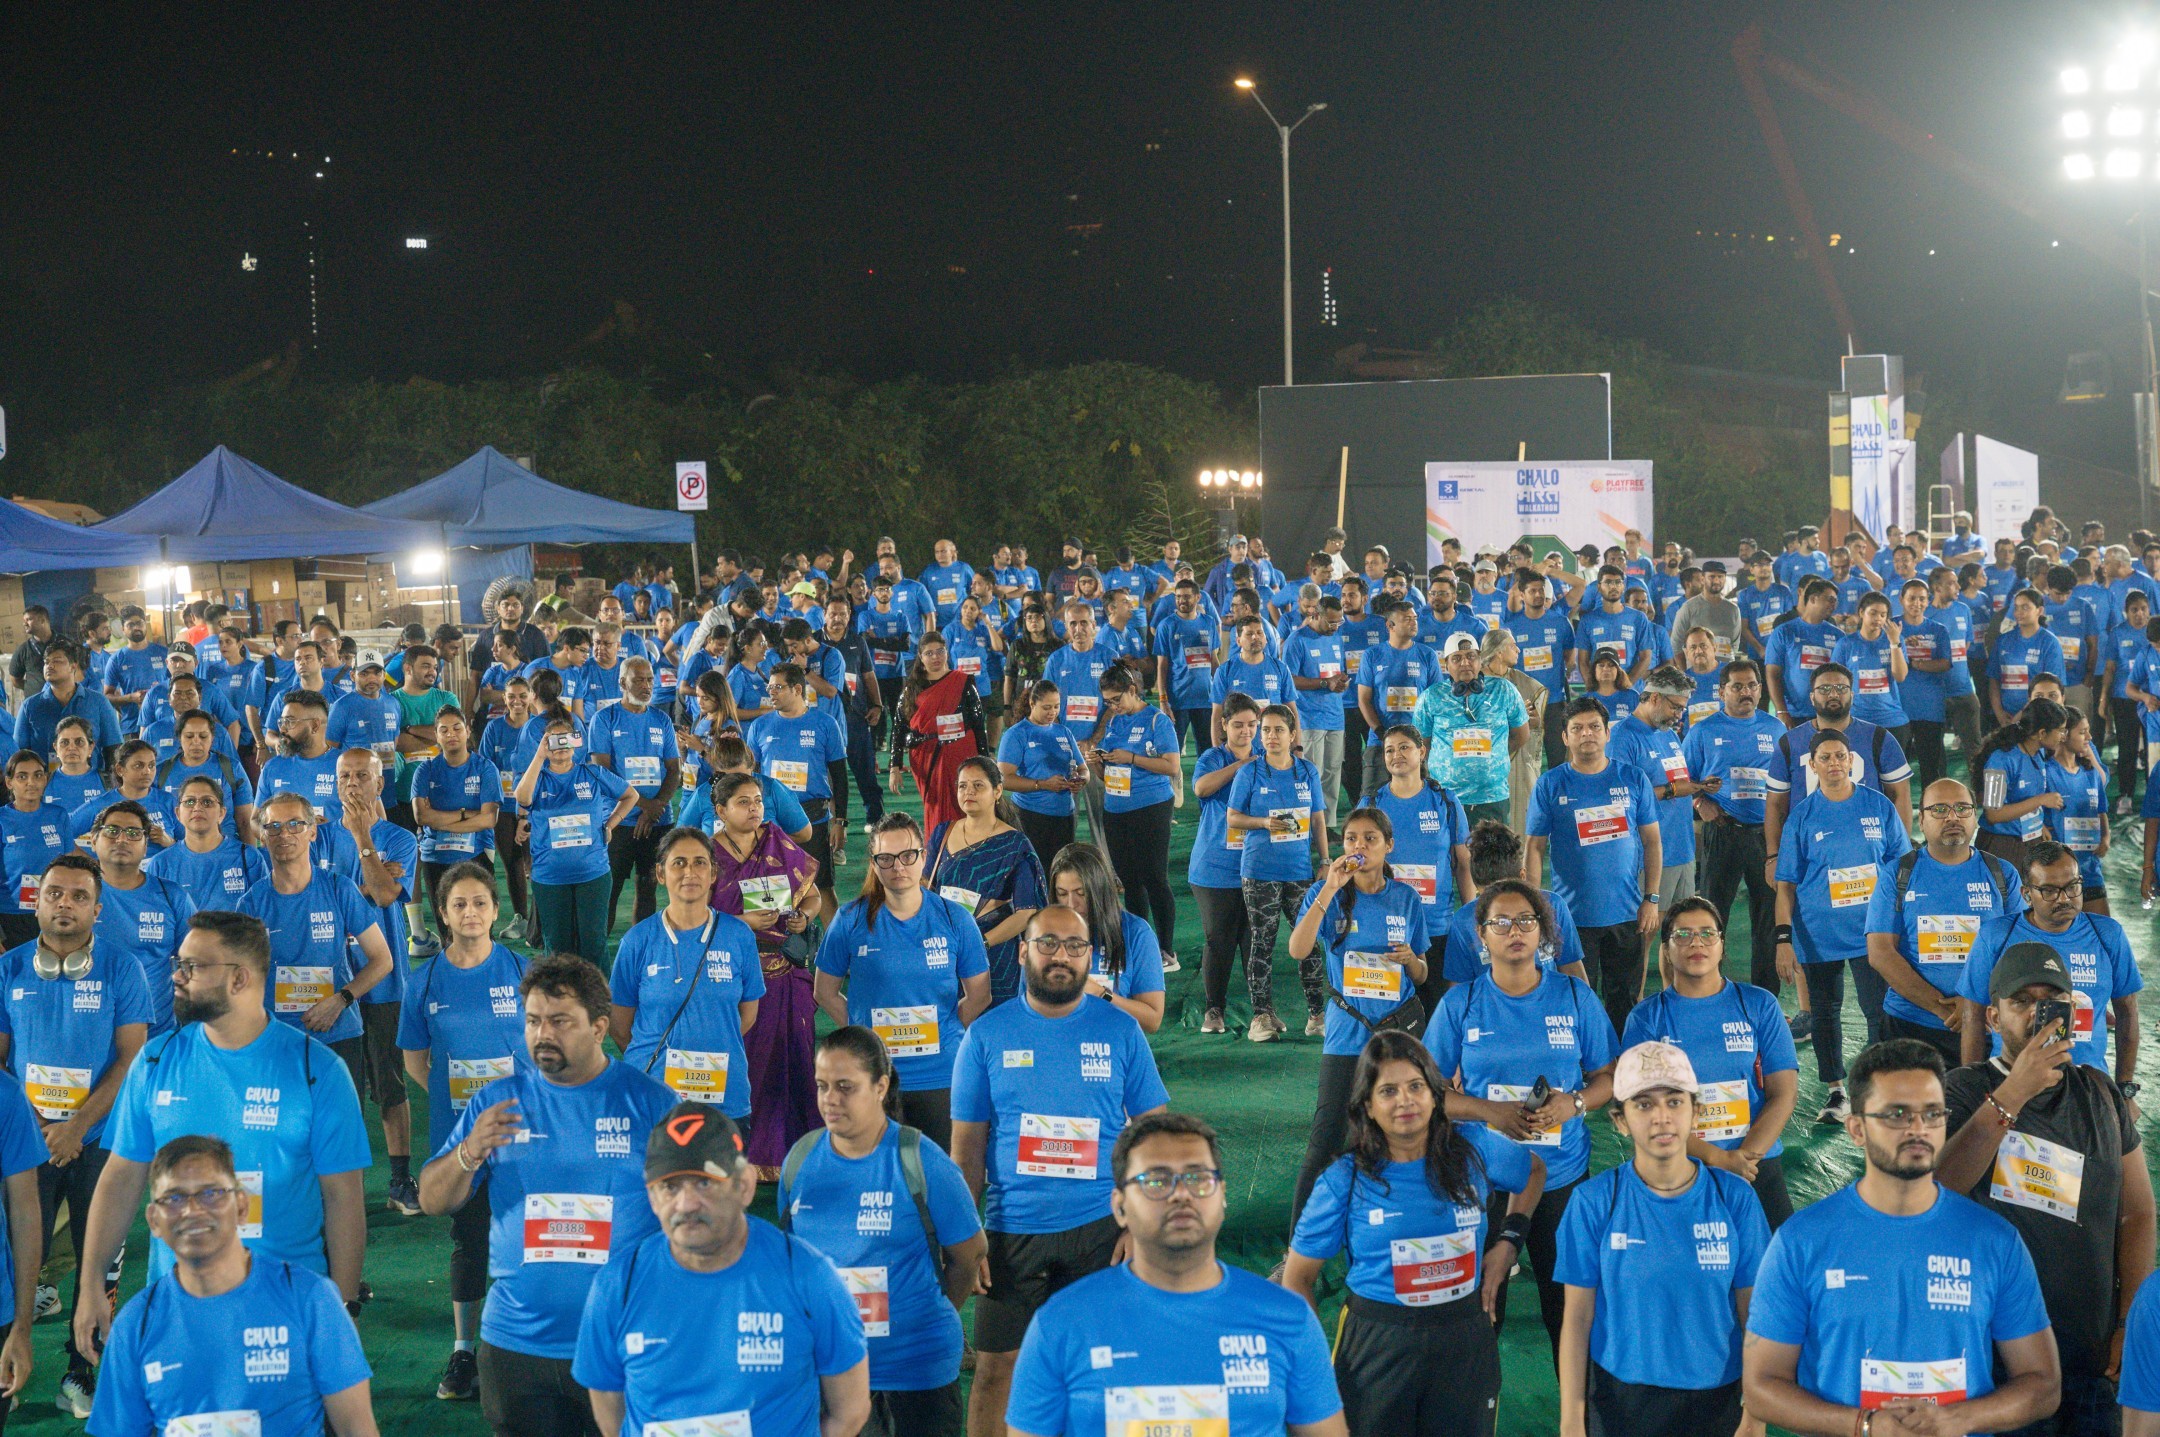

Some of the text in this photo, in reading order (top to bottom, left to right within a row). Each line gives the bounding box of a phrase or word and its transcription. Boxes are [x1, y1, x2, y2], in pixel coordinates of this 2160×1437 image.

[1517, 469, 1559, 488] CHALO
[1518, 503, 1558, 512] WALKATHON
[1845, 883, 1865, 891] 11213
[1966, 882, 1990, 894] CHALO
[140, 912, 164, 923] CHALO
[311, 912, 333, 923] CHALO
[923, 936, 947, 949] CHALO
[1937, 935, 1962, 943] 10051
[706, 950, 730, 963] CHALO
[2070, 953, 2096, 967] CHALO
[1362, 971, 1384, 980] 11099
[75, 981, 102, 992] CHALO
[293, 985, 318, 993] 10329
[490, 985, 514, 998] CHALO
[1545, 1015, 1573, 1028] CHALO
[893, 1027, 919, 1036] 11110
[1722, 1021, 1752, 1035] CHALO
[1080, 1042, 1110, 1057] CHALO
[685, 1072, 711, 1081] 11203
[1083, 1067, 1109, 1075] WALKATHON
[42, 1088, 69, 1098] 10019
[245, 1087, 280, 1104] CHALO
[246, 1114, 276, 1123] WALKATHON
[596, 1117, 630, 1133] CHALO
[598, 1143, 628, 1151] WALKATHON
[1042, 1141, 1074, 1152] 50131
[2024, 1165, 2058, 1184] 10304
[860, 1191, 892, 1208] CHALO
[549, 1222, 585, 1234] 50388
[859, 1219, 890, 1228] WALKATHON
[1693, 1222, 1728, 1241] CHALO
[1699, 1252, 1728, 1261] WALKATHON
[1421, 1262, 1456, 1277] 51197
[1928, 1255, 1971, 1278] CHALO
[1930, 1290, 1968, 1302] WALKATHON
[738, 1312, 784, 1335] CHALO
[244, 1326, 289, 1348] CHALO
[1219, 1335, 1267, 1358] CHALO
[741, 1351, 780, 1362] WALKATHON
[248, 1361, 287, 1372] WALKATHON
[1227, 1373, 1267, 1384] WALKATHON
